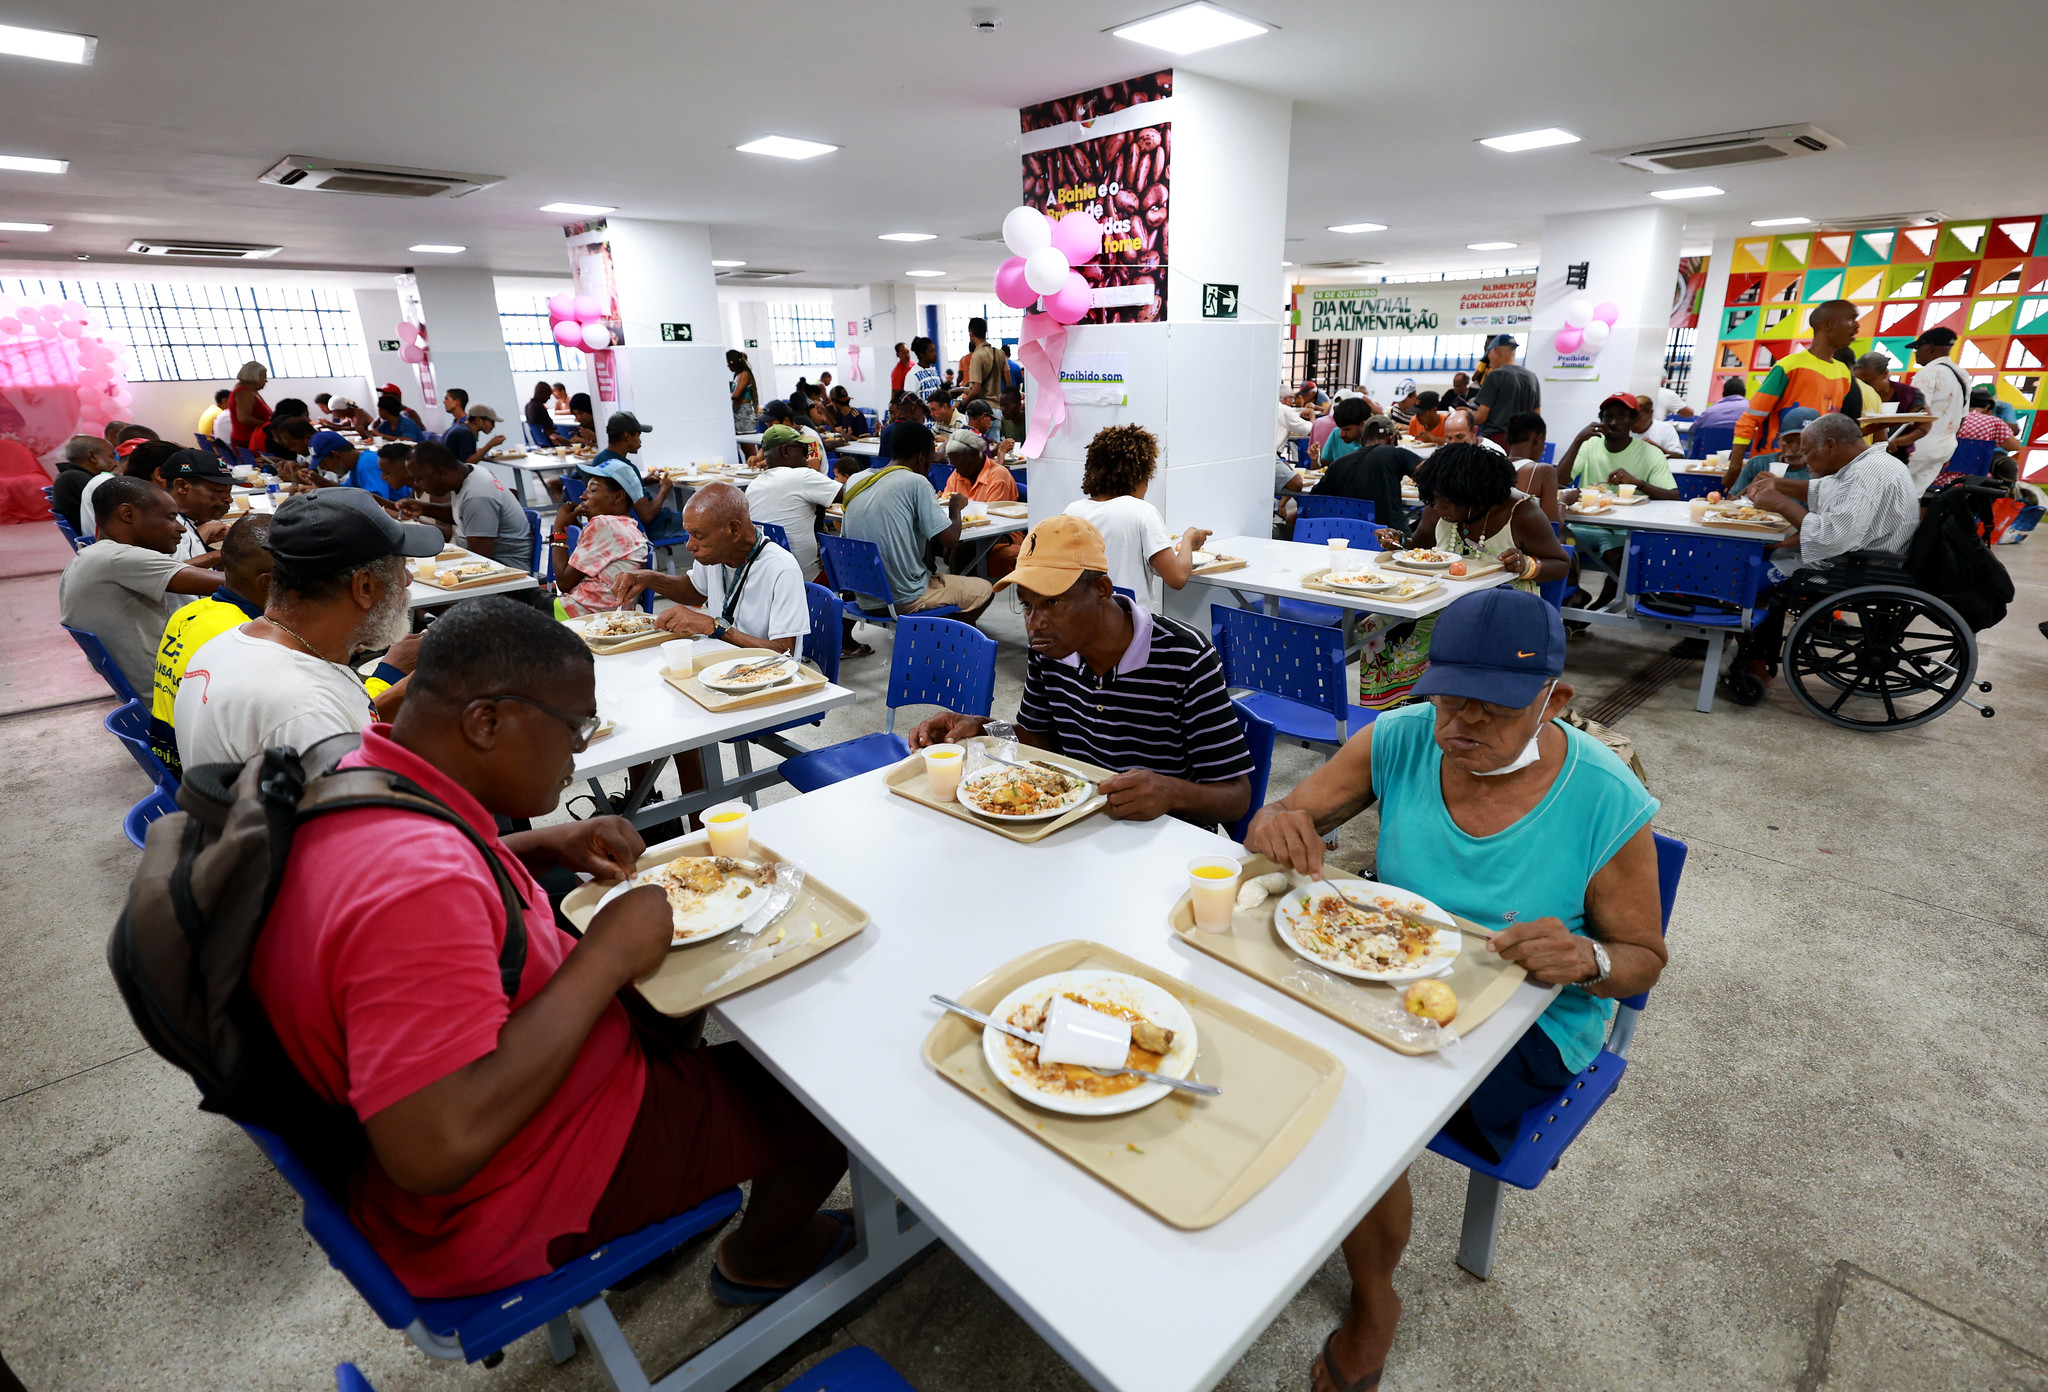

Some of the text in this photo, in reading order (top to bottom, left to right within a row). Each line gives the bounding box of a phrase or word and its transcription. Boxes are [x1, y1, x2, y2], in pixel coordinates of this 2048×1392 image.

[1046, 181, 1119, 206] A Bahia e o
[1084, 200, 1103, 217] de
[1104, 236, 1143, 254] fome
[1337, 289, 1377, 298] OUTUBRO
[1461, 292, 1509, 301] ADEQUADA
[1313, 297, 1412, 316] DIA MUNDIAL
[1466, 301, 1480, 309] UM
[1480, 300, 1516, 309] DIREITO
[1516, 299, 1528, 307] DE
[1312, 309, 1439, 333] DA ALIMENTAÇÃO
[1060, 370, 1123, 381] Proibido som
